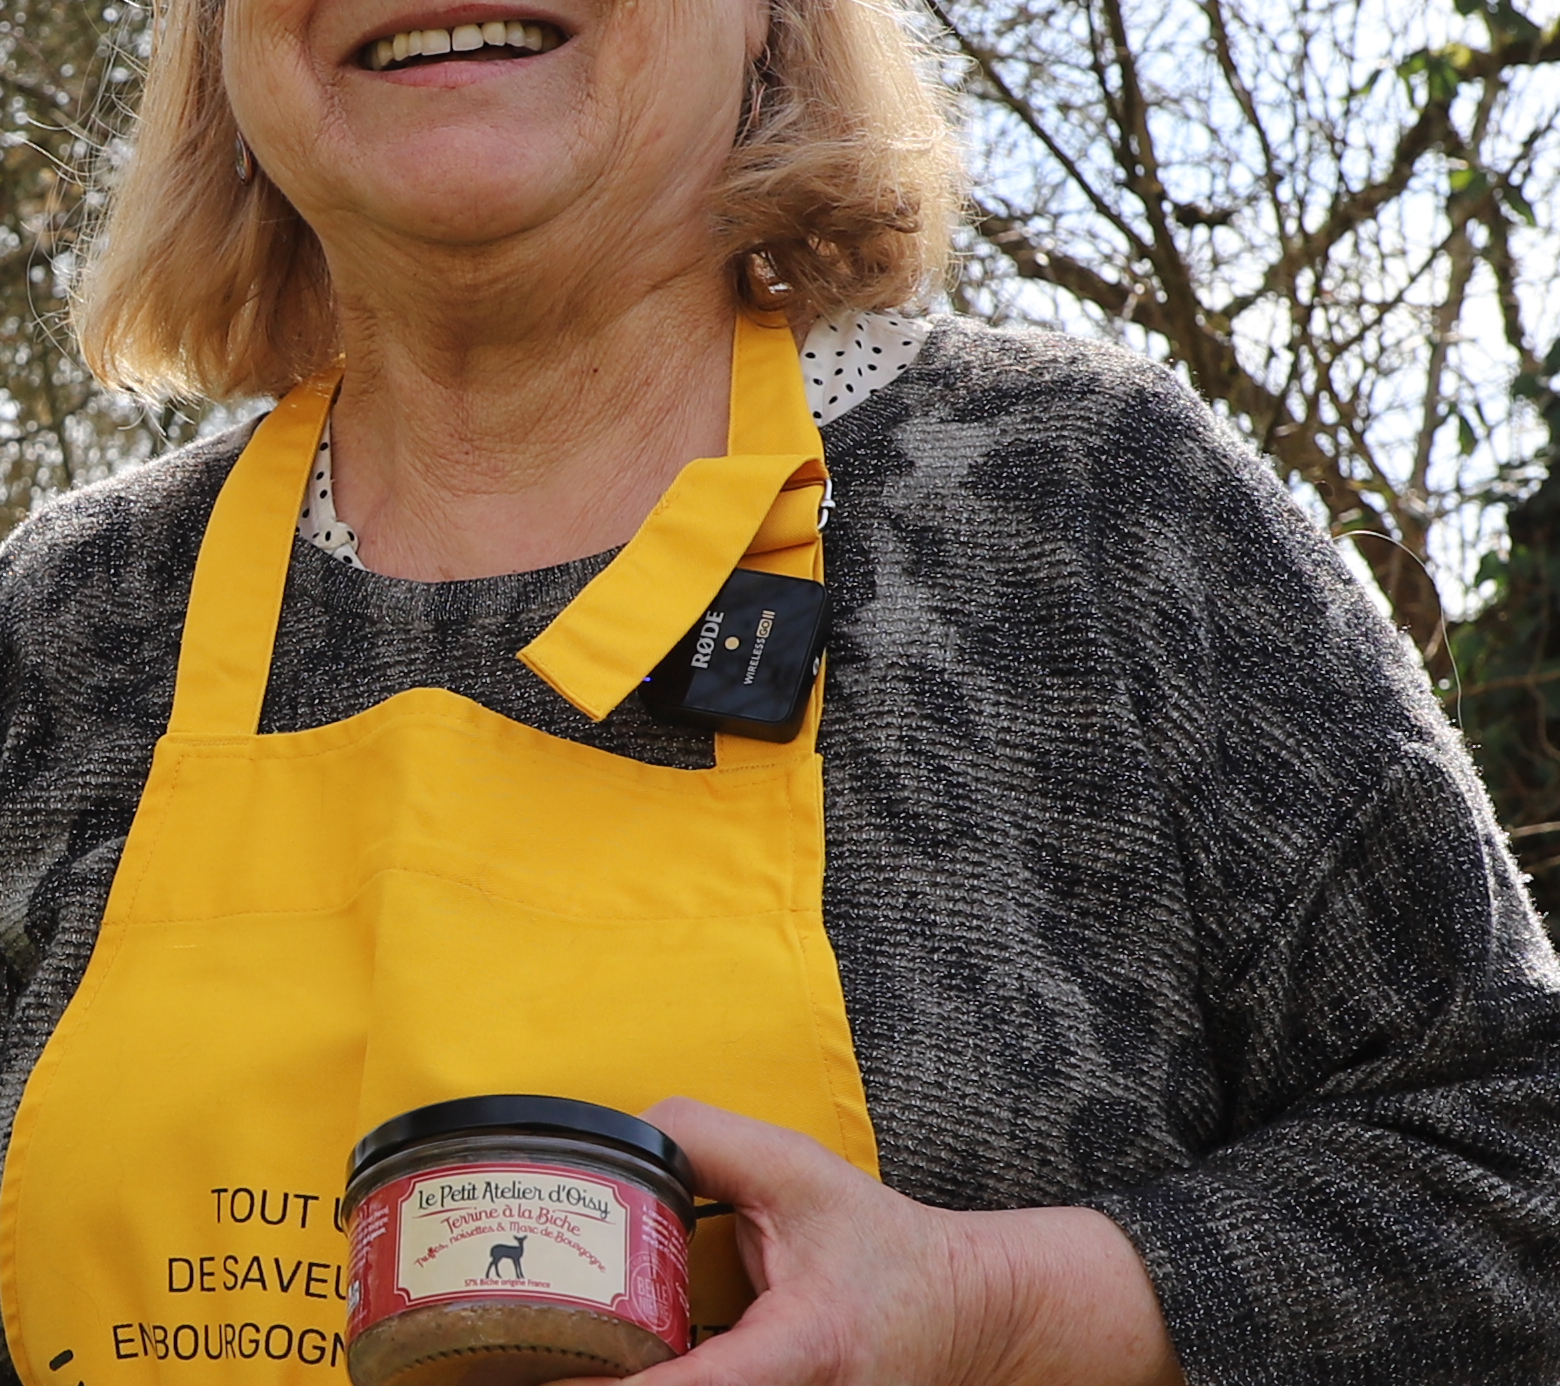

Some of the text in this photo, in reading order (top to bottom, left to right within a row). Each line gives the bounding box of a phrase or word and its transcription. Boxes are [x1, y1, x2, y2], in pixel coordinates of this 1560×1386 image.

[691, 611, 724, 668] RØDE
[743, 637, 766, 685] WIRELESS
[211, 1188, 319, 1228] TOUT
[418, 1180, 610, 1220] Le Petit Atelier d'Oisy
[440, 1203, 581, 1236] Terrine à la Biche
[449, 1225, 495, 1244] noisettes
[496, 1222, 505, 1233] &
[510, 1221, 539, 1234] Marc
[540, 1226, 554, 1239] de
[554, 1231, 607, 1274] Bourgogne
